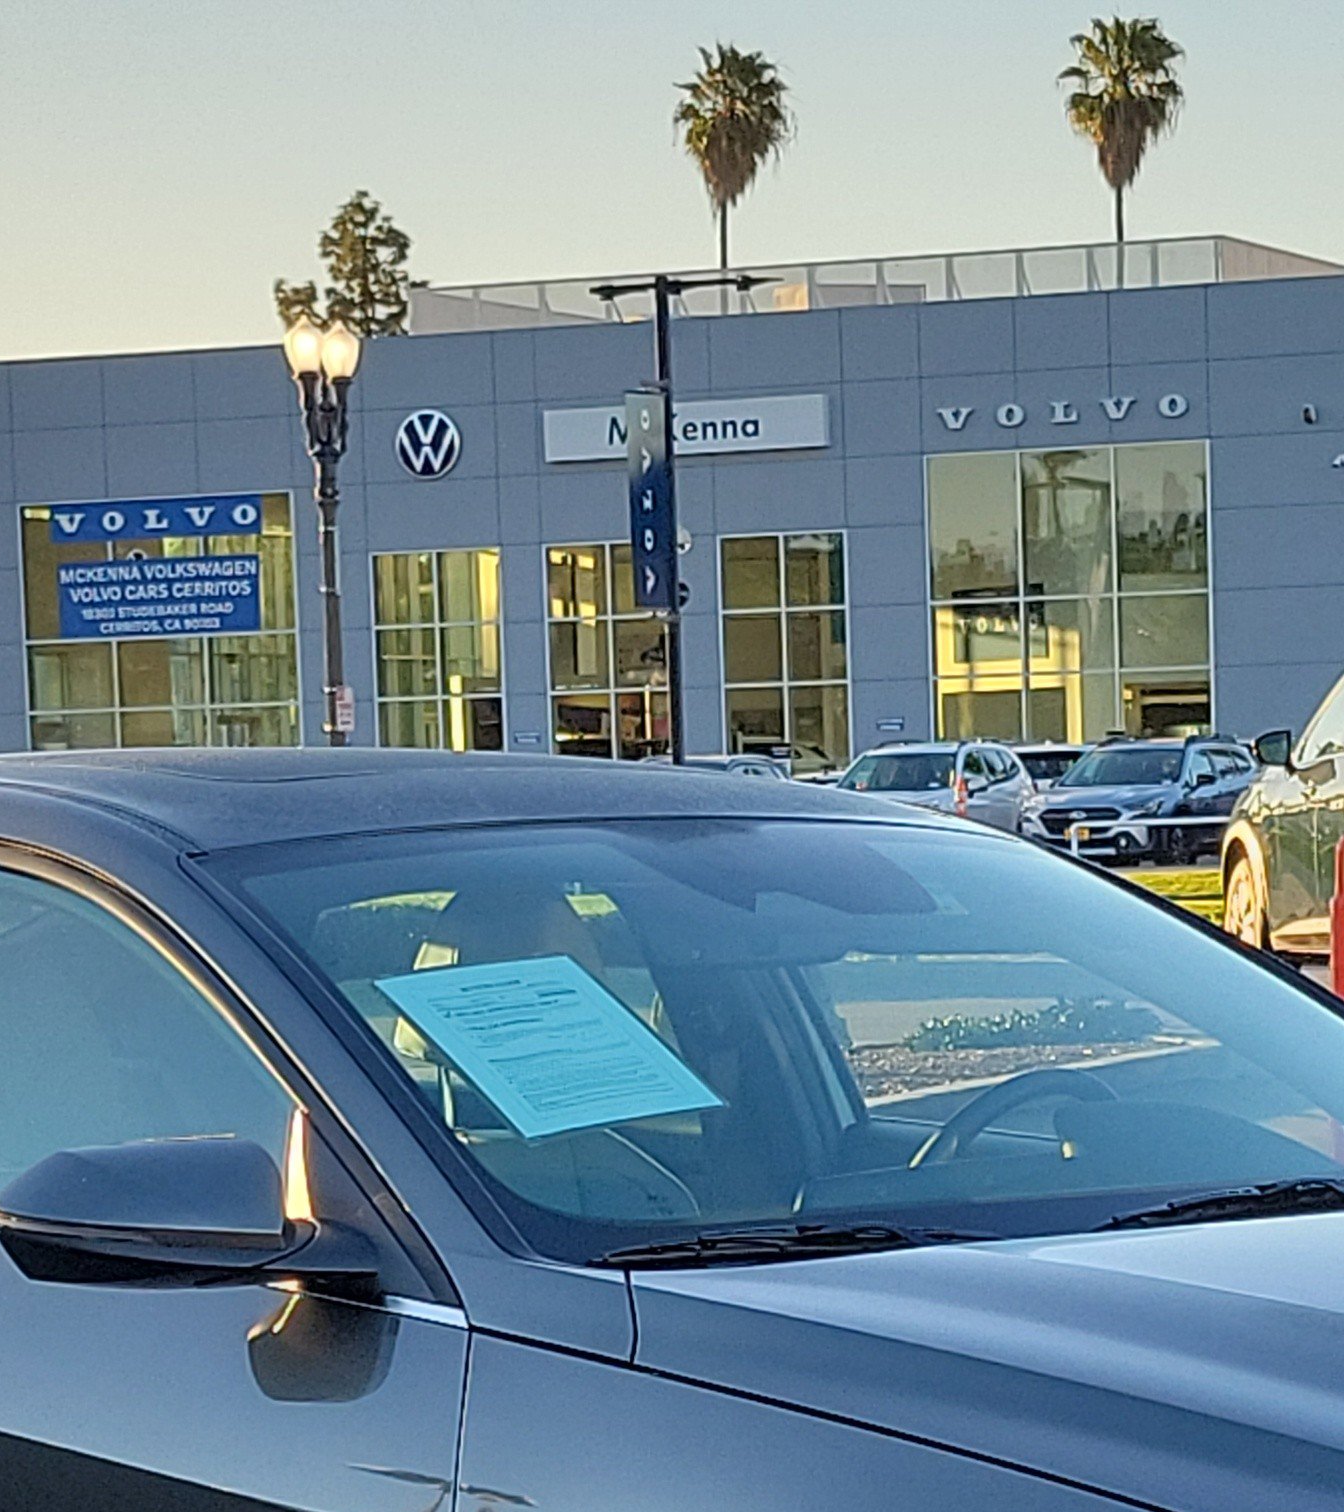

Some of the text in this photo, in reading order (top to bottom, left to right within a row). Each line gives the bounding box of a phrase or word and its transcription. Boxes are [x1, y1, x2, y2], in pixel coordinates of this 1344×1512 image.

[935, 393, 1189, 431] VOLVO
[608, 412, 760, 446] Menna
[640, 408, 656, 595] VOLVO
[53, 503, 257, 534] VOLVO
[59, 560, 257, 585] MCKENNA VOLKSWAGEN
[69, 580, 252, 603] VOLVO CARS CERRITOS
[200, 601, 234, 615] ROAD
[163, 618, 181, 631] CA
